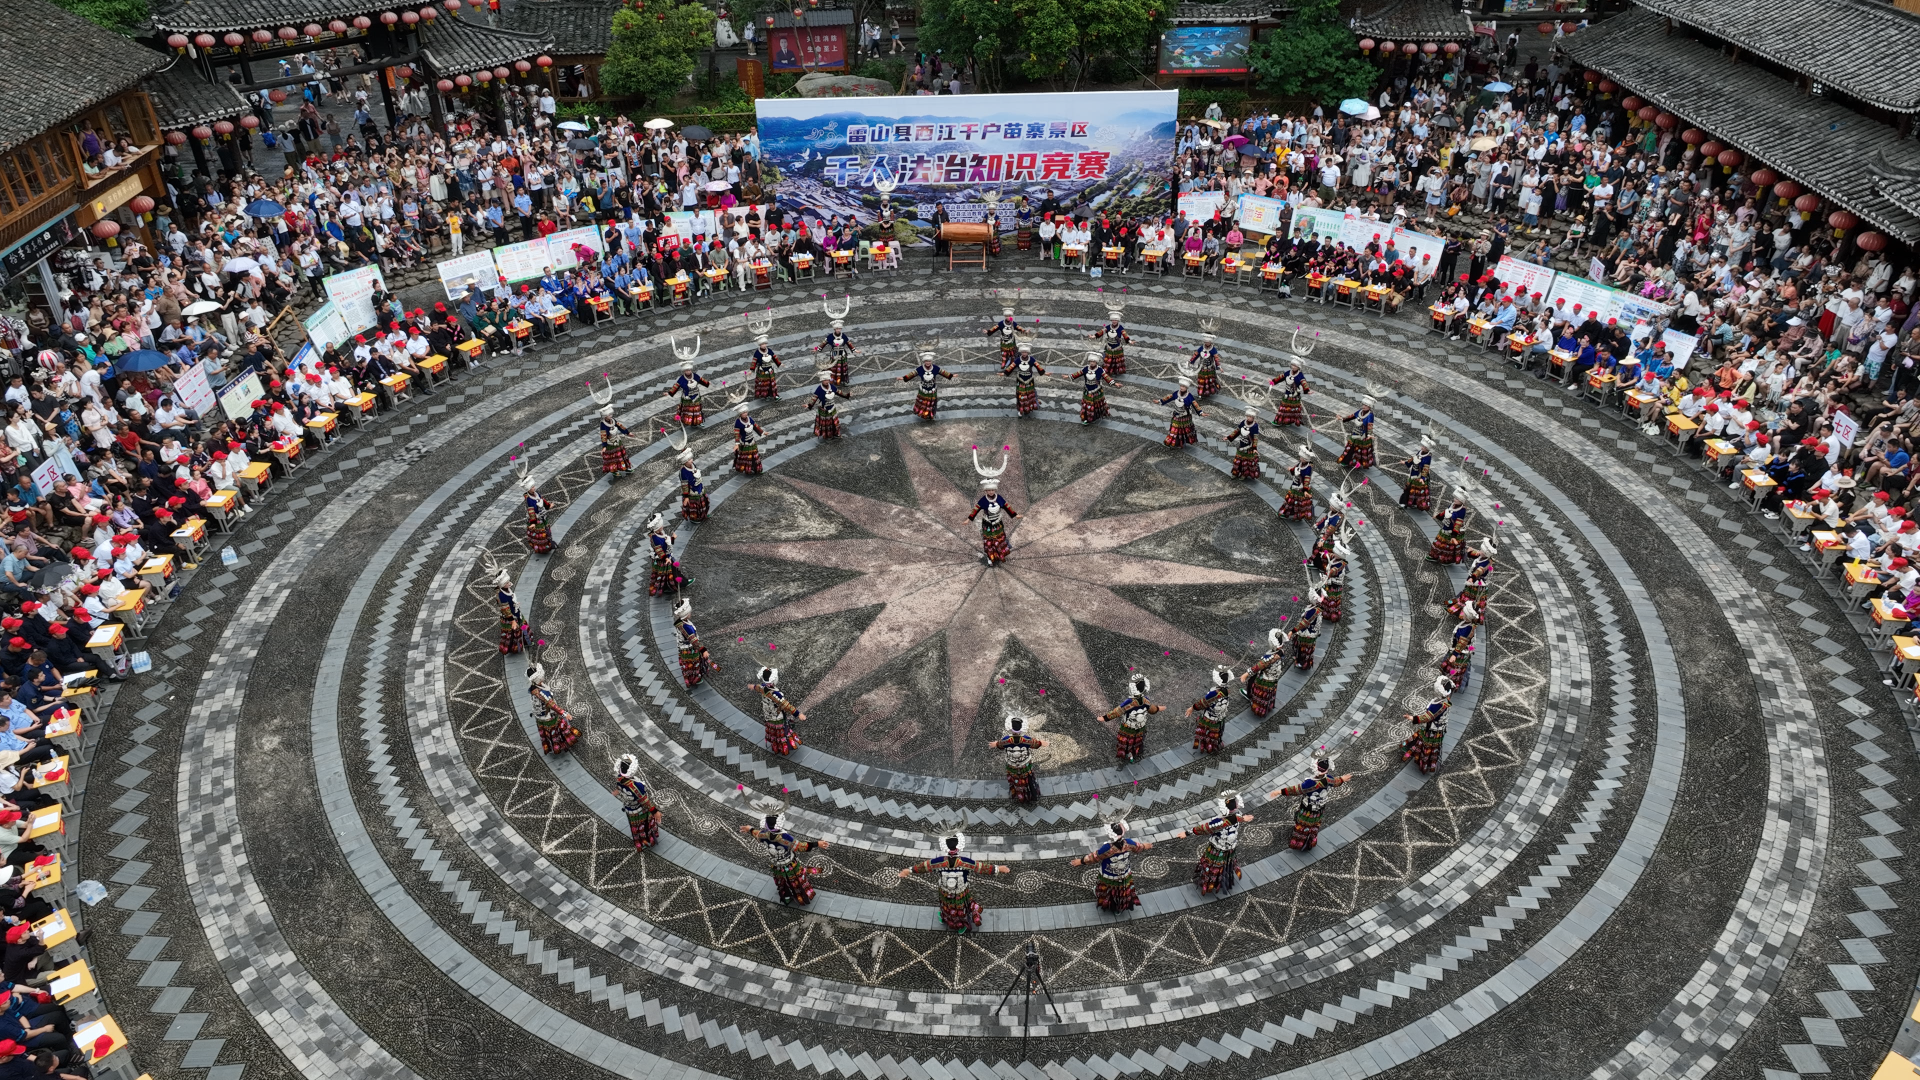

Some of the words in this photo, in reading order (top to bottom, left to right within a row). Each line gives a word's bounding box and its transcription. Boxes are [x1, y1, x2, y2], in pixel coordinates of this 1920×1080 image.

[806, 35, 838, 43] 关注消防
[807, 45, 838, 53] 生命至上
[846, 121, 1090, 145] 雷山县西江千户苗寨景区
[824, 150, 1111, 188] 千人法治知识竞赛
[1834, 418, 1853, 442] 七区
[38, 464, 60, 489] 二区
